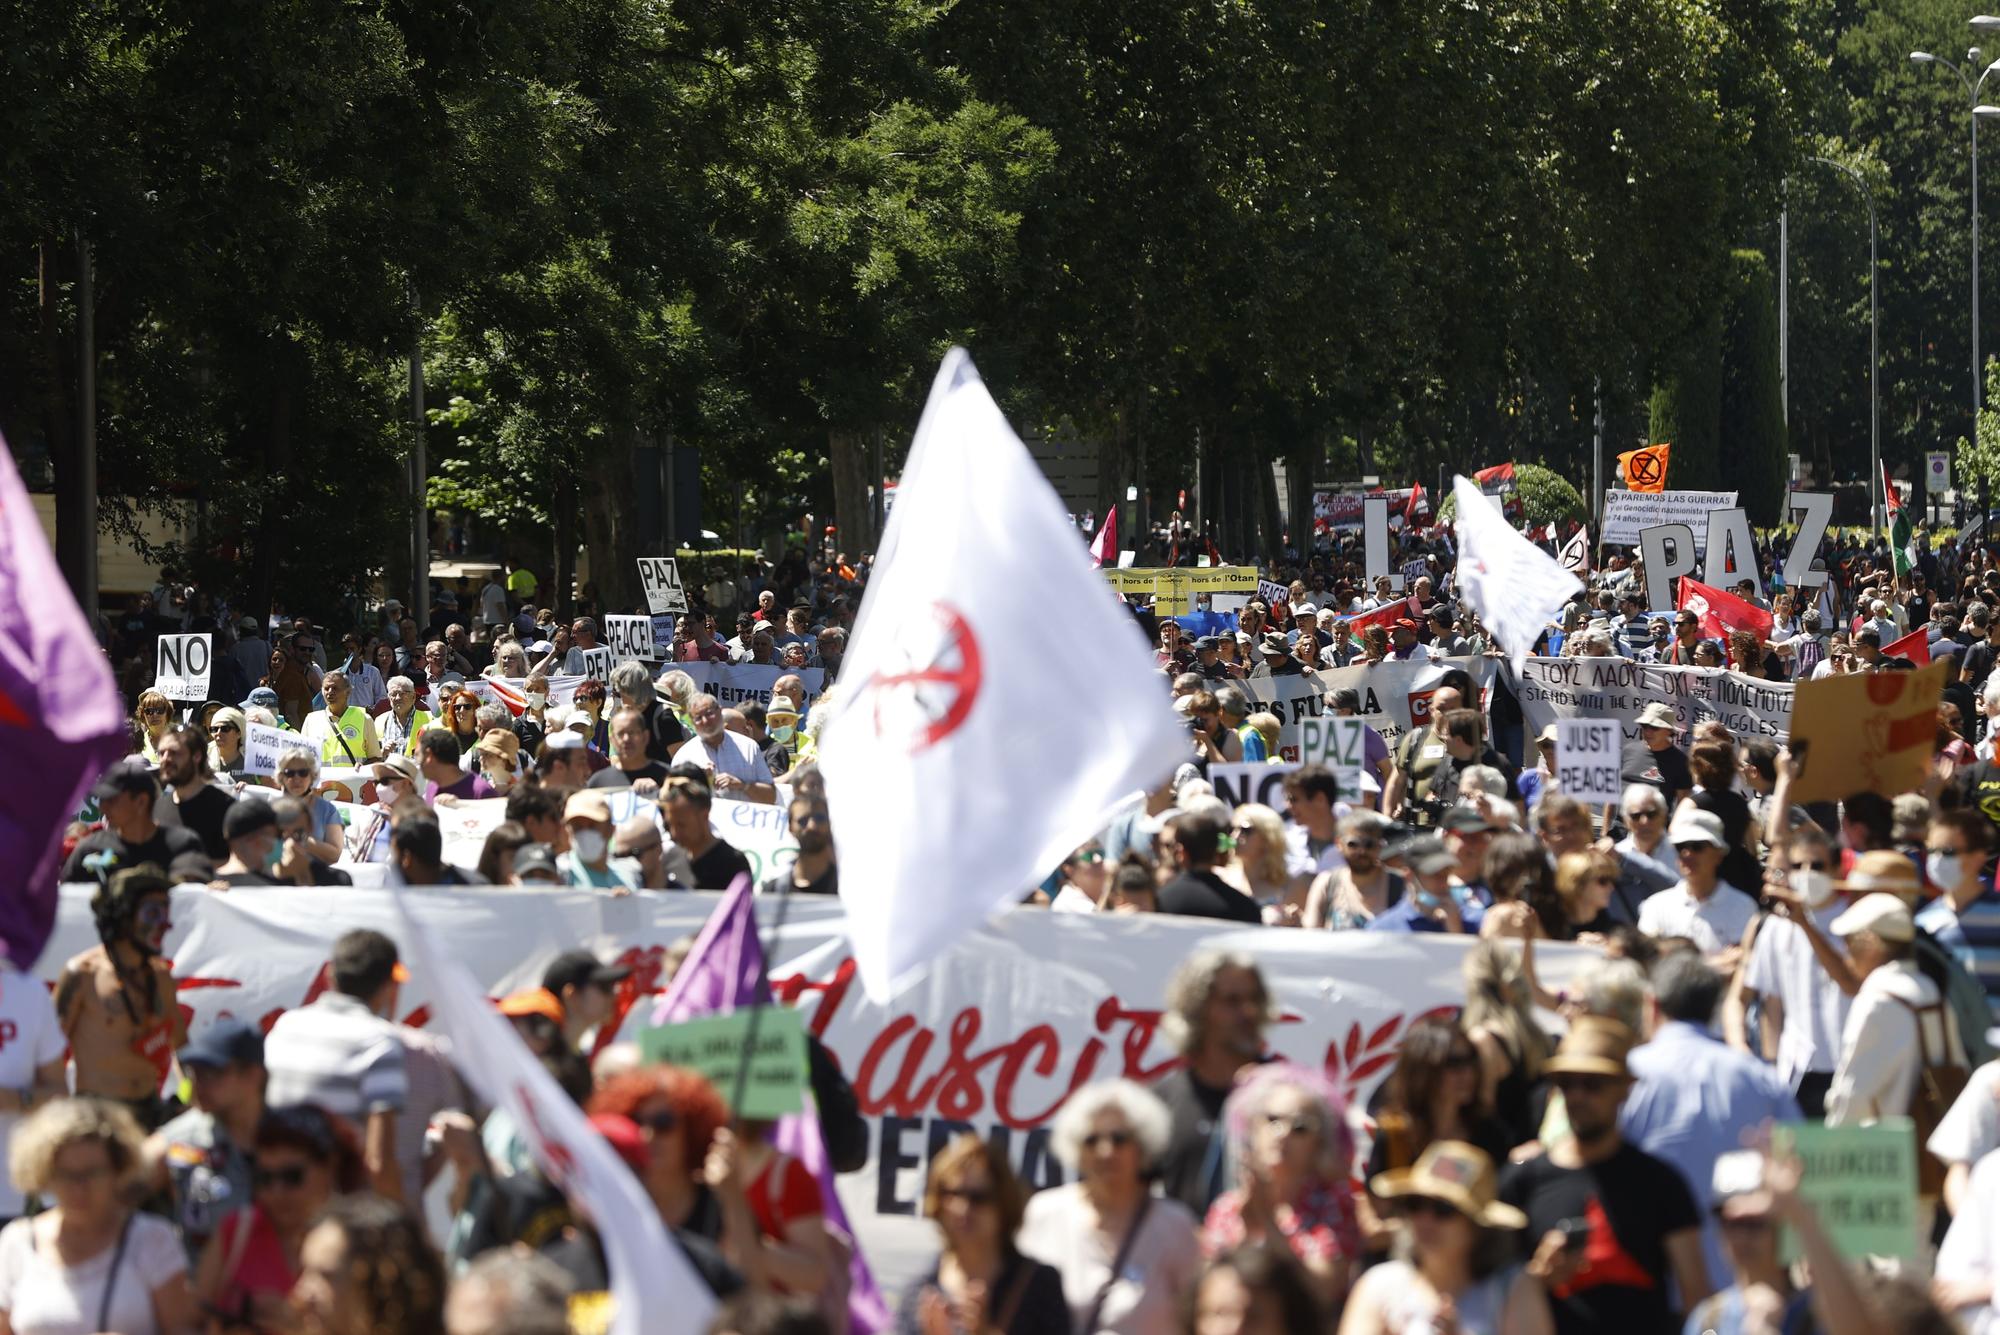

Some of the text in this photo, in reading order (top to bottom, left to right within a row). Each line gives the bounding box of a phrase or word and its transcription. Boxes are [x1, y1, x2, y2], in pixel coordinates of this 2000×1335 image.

[1621, 493, 1731, 505] PAREMOS LAS GUERRAS
[1622, 515, 1640, 523] años
[1638, 490, 1834, 611] PAZ
[638, 559, 681, 590] PAZ
[1123, 577, 1141, 585] hors
[1143, 576, 1153, 585] de
[1191, 576, 1209, 584] hors
[1211, 575, 1221, 584] de
[1224, 574, 1254, 583] l'Otan
[607, 619, 653, 656] PEACE!
[159, 636, 209, 676] NO
[1527, 687, 1569, 706] STAND
[1572, 694, 1604, 711] WITH
[1608, 694, 1628, 710] THE
[251, 728, 280, 749] Guerras
[1302, 720, 1362, 767] PAZ
[1565, 727, 1613, 753] JUST
[1560, 766, 1620, 795] PEACE!
